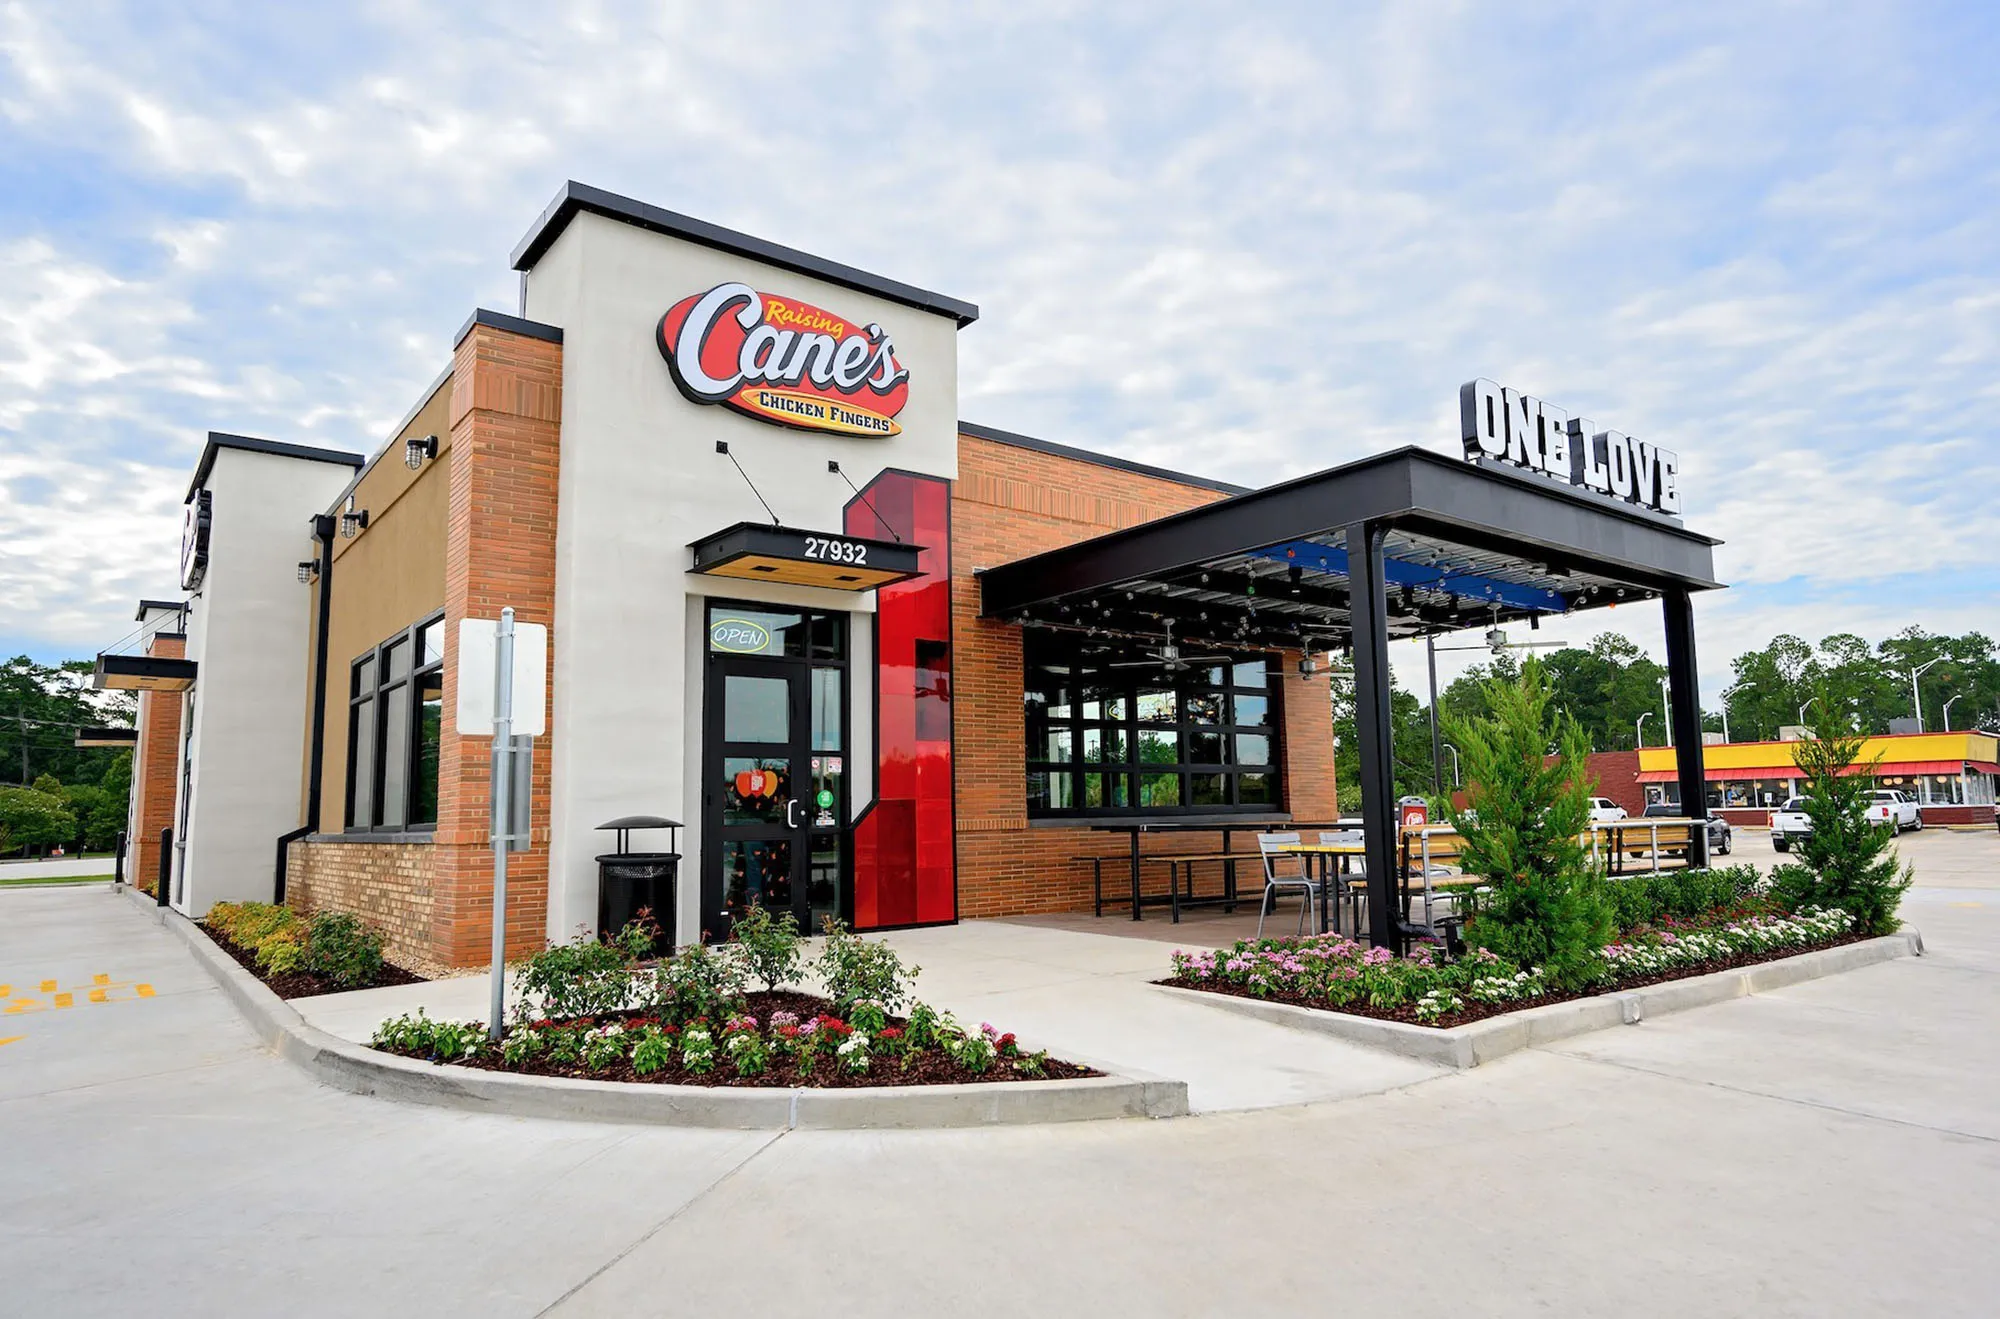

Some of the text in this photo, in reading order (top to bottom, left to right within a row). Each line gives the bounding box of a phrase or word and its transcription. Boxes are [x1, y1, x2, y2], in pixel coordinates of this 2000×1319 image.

[675, 281, 910, 396] Cane's
[765, 300, 845, 339] Raising
[759, 391, 890, 432] CHICKEN FINGERS
[1460, 377, 1682, 514] ONE LOVE
[804, 537, 867, 565] 27932
[714, 628, 763, 646] OPEN
